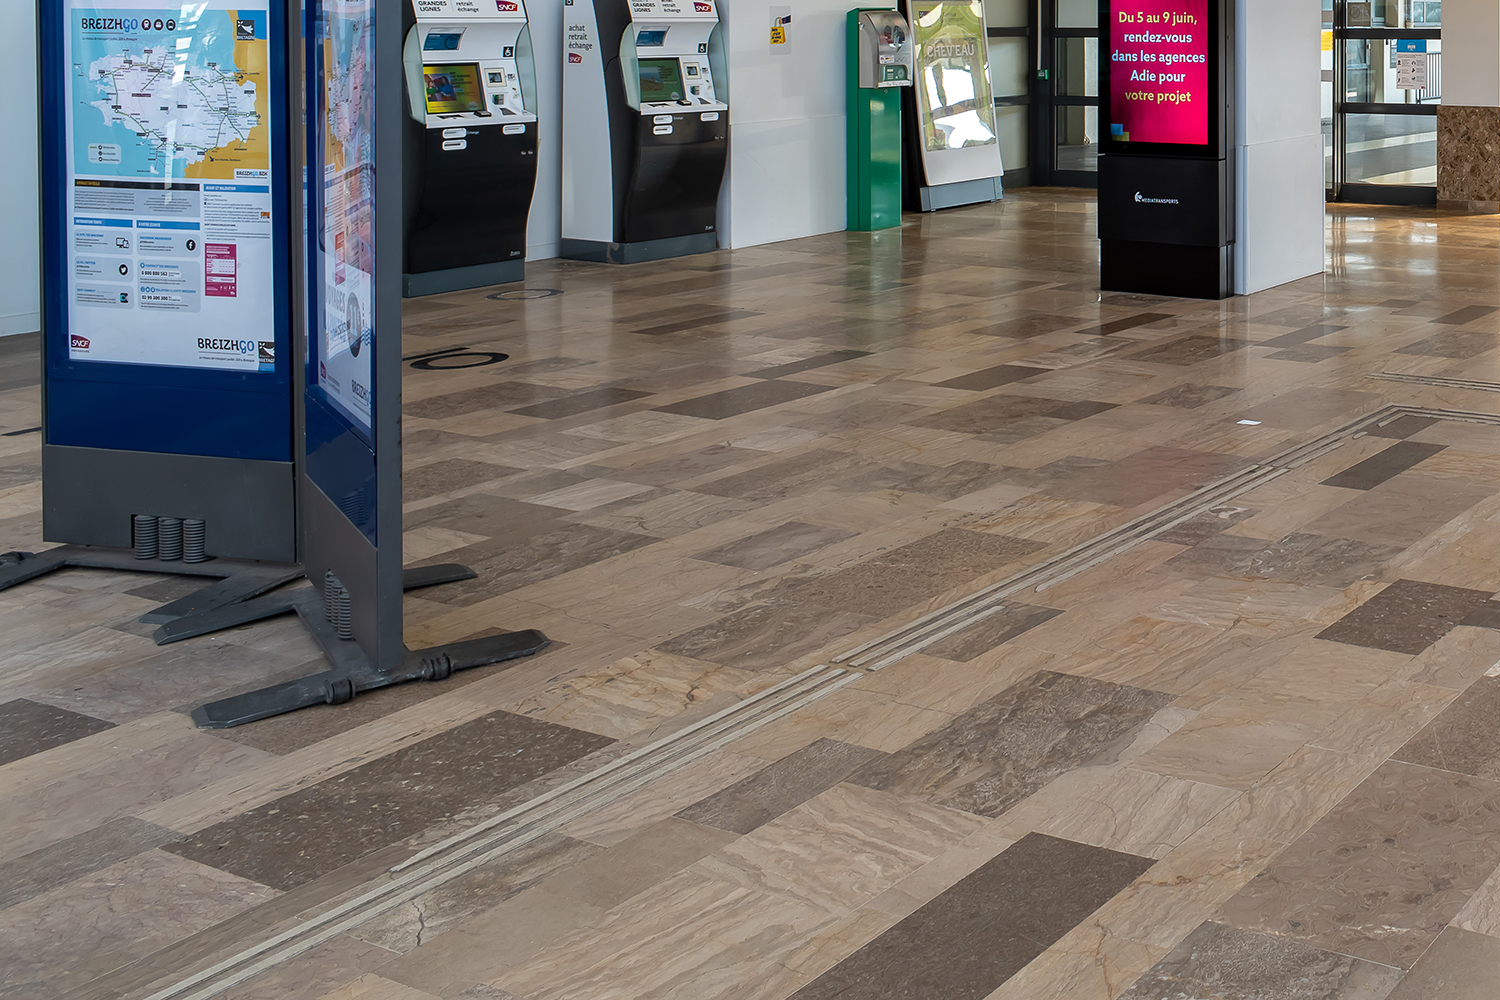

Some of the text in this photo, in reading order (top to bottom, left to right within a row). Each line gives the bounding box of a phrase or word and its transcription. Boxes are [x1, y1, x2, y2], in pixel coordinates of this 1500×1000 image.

[81, 18, 138, 32] BREIZHGO
[1124, 30, 1193, 43] rendez-vous
[568, 42, 593, 51] échange
[1111, 49, 1206, 66] dans agences
[1130, 69, 1156, 81] Adie
[1125, 90, 1155, 101] votre
[197, 338, 254, 354] BREIZHGO
